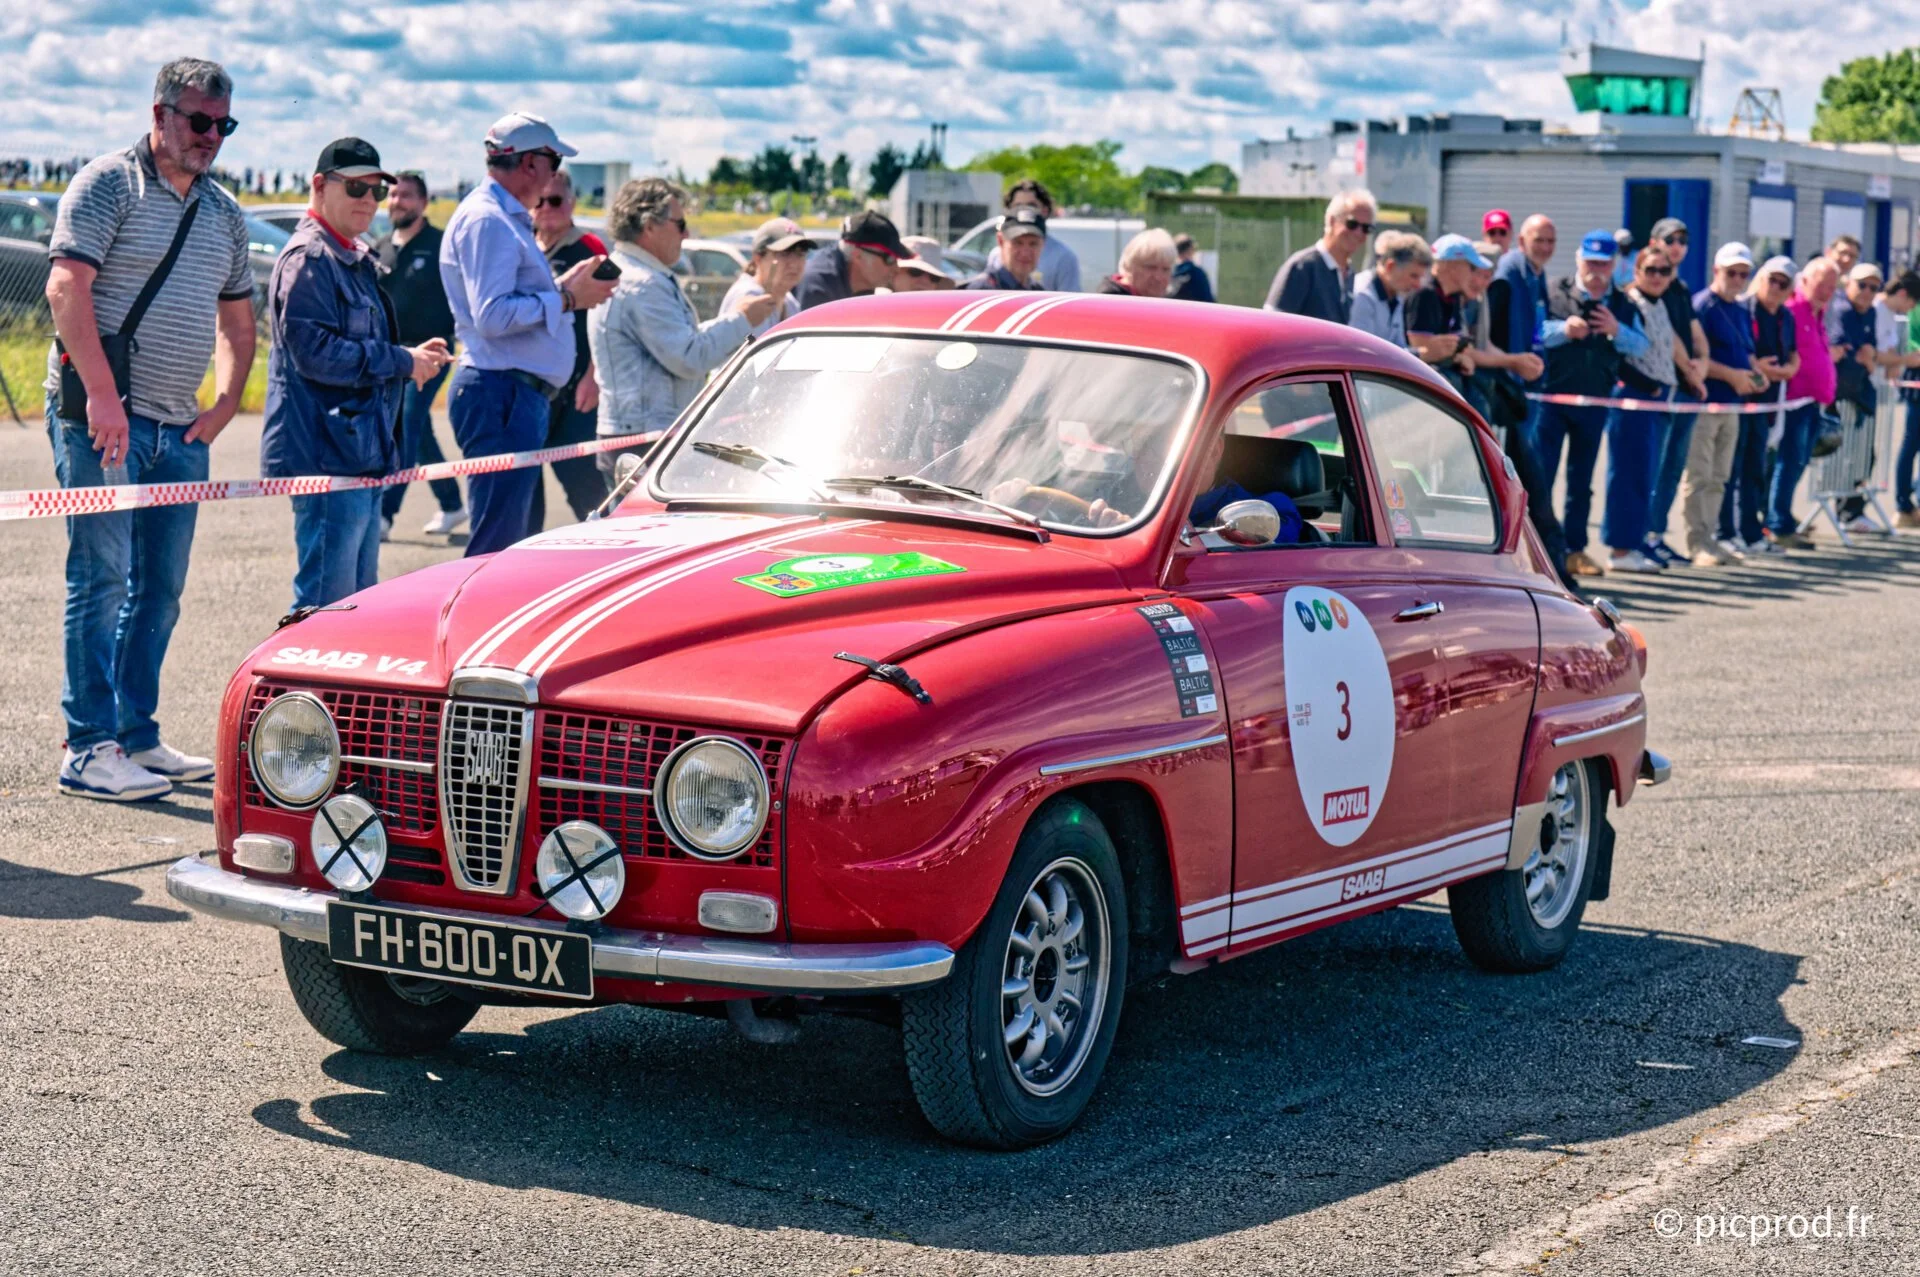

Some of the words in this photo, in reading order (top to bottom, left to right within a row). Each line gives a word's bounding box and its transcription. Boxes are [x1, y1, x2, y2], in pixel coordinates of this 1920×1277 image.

[818, 560, 844, 569] 3
[1165, 636, 1196, 651] BALTIC
[271, 647, 368, 672] SAAB
[376, 655, 428, 676] V4
[1179, 675, 1209, 691] BALTIC
[1336, 681, 1351, 741] 3
[466, 731, 505, 786] SAAB
[1325, 791, 1368, 821] MOTUL
[1342, 868, 1385, 901] SAAB
[353, 911, 565, 987] FH-600-QX
